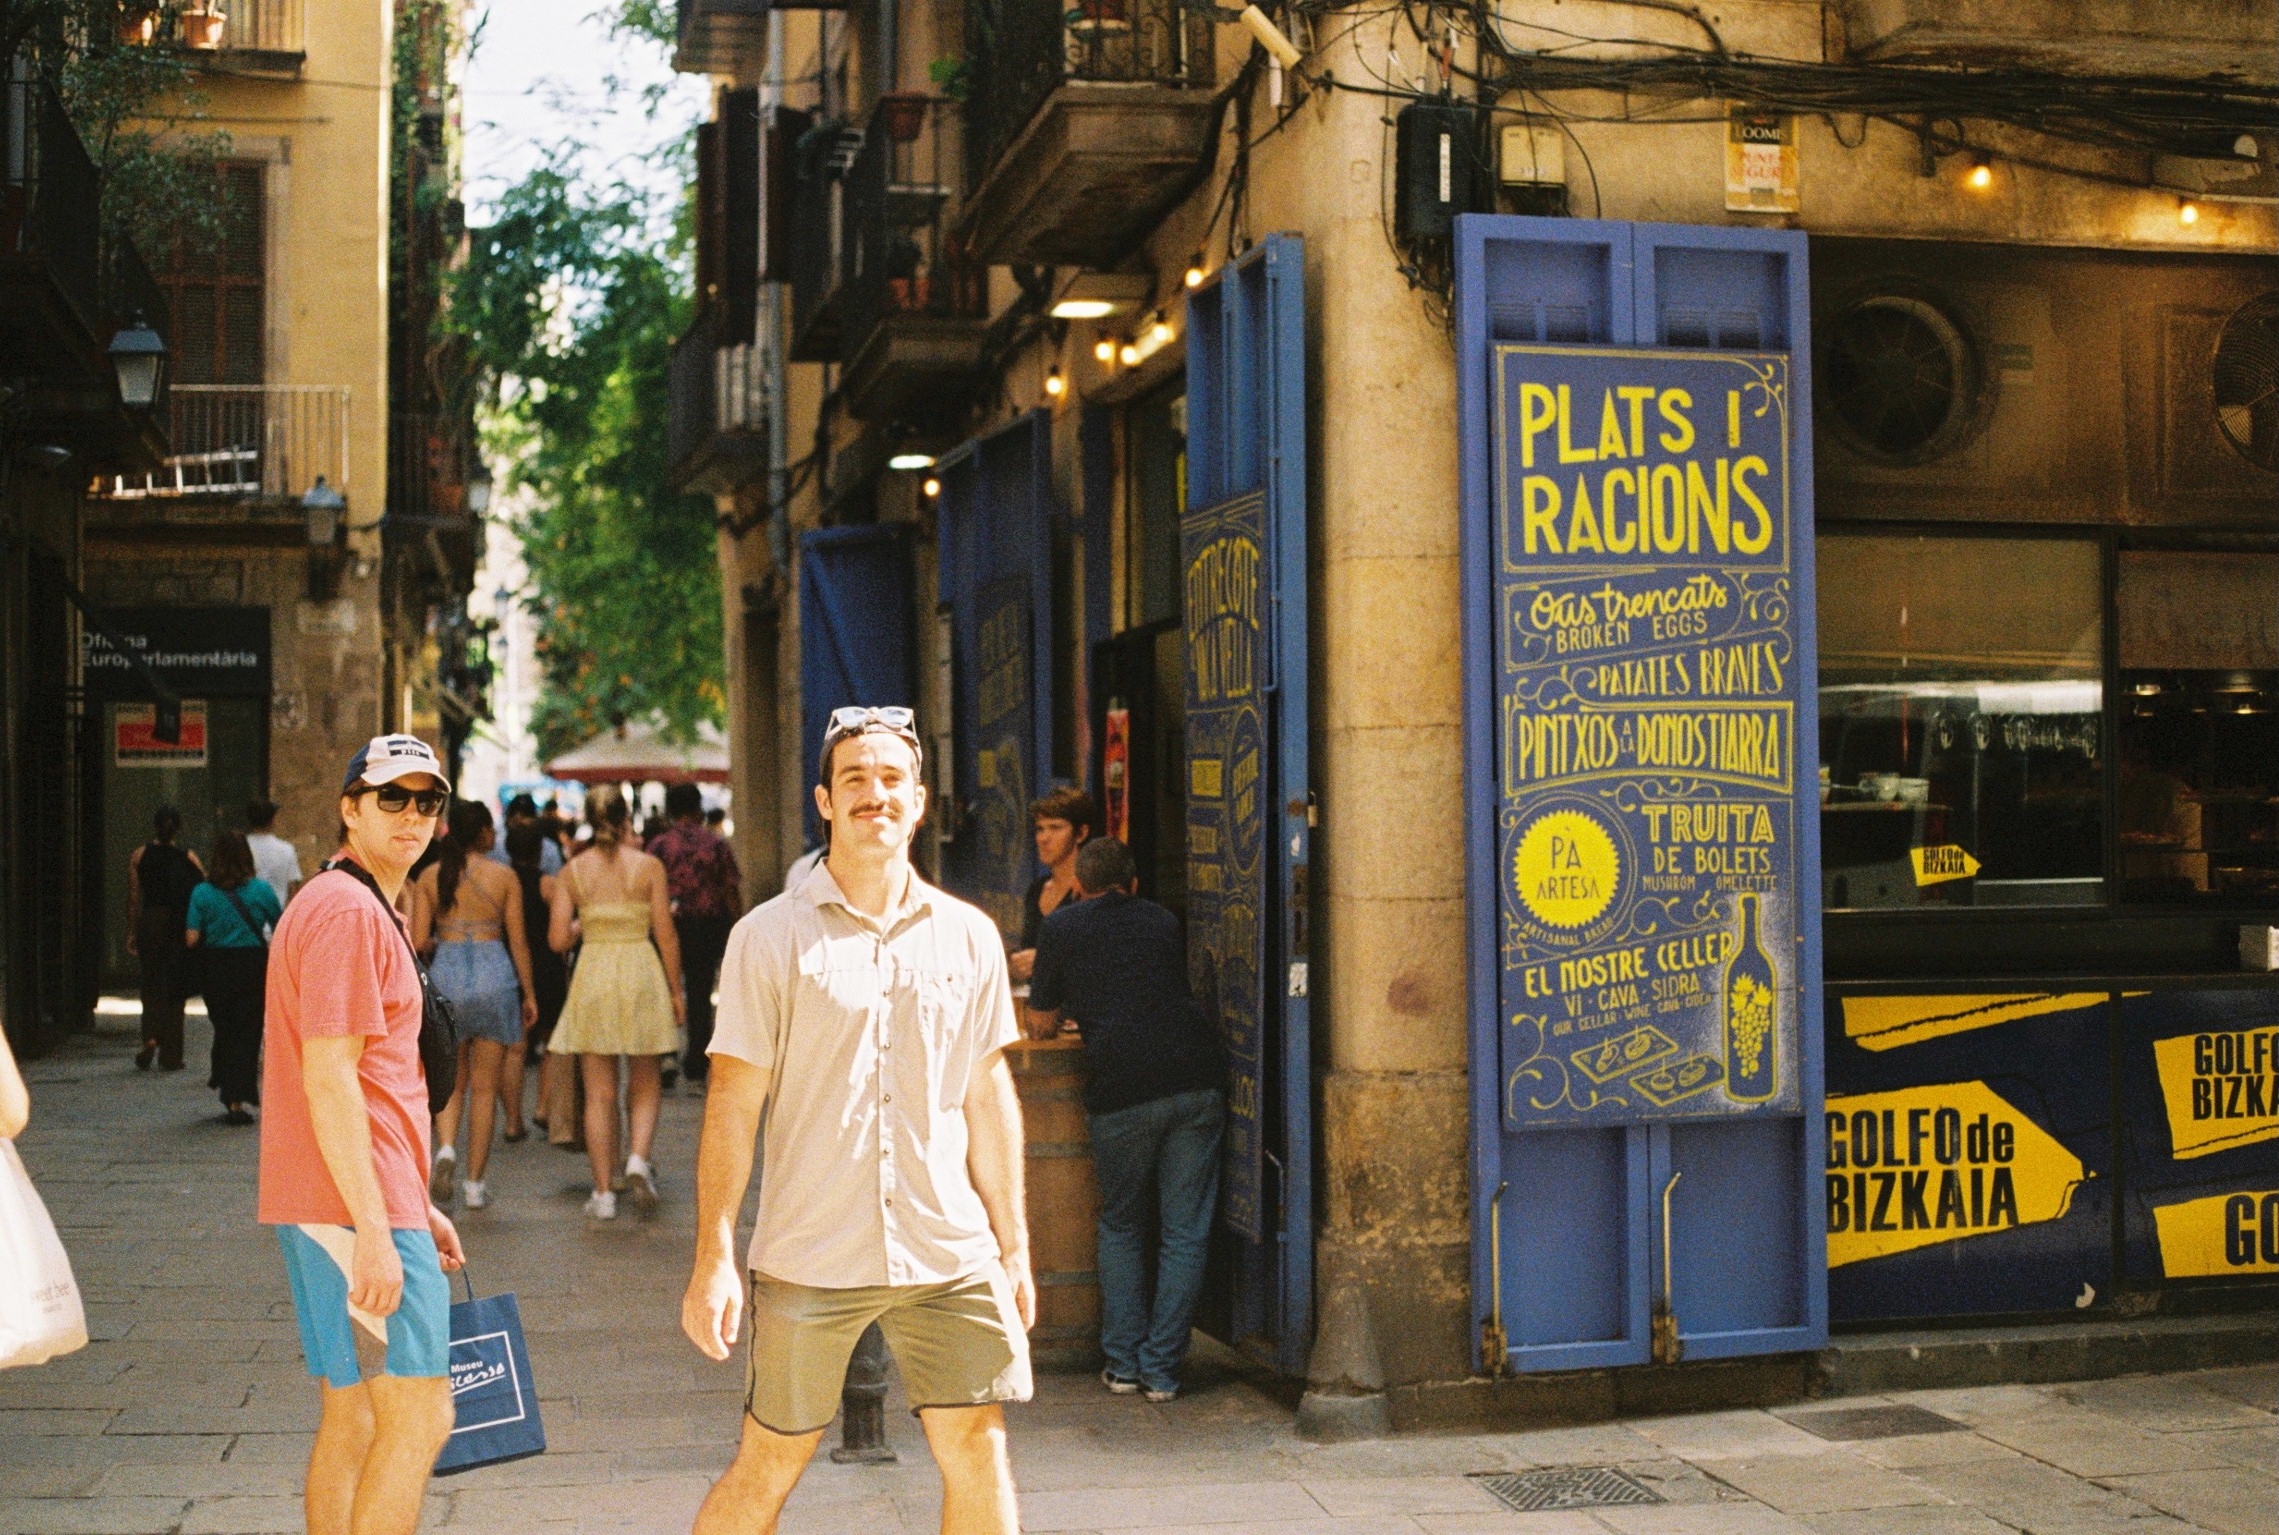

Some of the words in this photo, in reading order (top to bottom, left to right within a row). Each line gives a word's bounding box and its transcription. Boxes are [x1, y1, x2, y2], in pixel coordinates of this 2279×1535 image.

[1519, 382, 1695, 468] PLATS
[1727, 389, 1740, 448] I
[1522, 454, 1773, 555] RACIONS
[1591, 574, 1728, 620] trencats
[1556, 620, 1630, 654] BROKEN
[1652, 611, 1708, 640] EGGS
[1599, 653, 1691, 697] PATATES
[1700, 640, 1784, 696] BRAVES
[1519, 713, 1619, 780] PINTXOS
[1636, 713, 1780, 779] DONOSTIARRA
[1641, 804, 1775, 843] TRUITA
[1653, 846, 1682, 874] DE
[1694, 846, 1772, 874] BOLETS
[1715, 874, 1778, 892] OMELETTE
[1923, 861, 1966, 875] BIZKAIA
[1524, 964, 1553, 998] EL
[1560, 947, 1648, 992] NOSTRE
[1656, 931, 1734, 973] CELLER
[1564, 994, 1583, 1018] VI
[1597, 983, 1640, 1012] CAVA
[1651, 971, 1701, 1002] SIDRA
[1825, 1107, 1961, 1170] GOLFO
[1967, 1113, 2015, 1164] de
[1826, 1167, 2020, 1234] BIZKAIA
[450, 1360, 484, 1373] Museu
